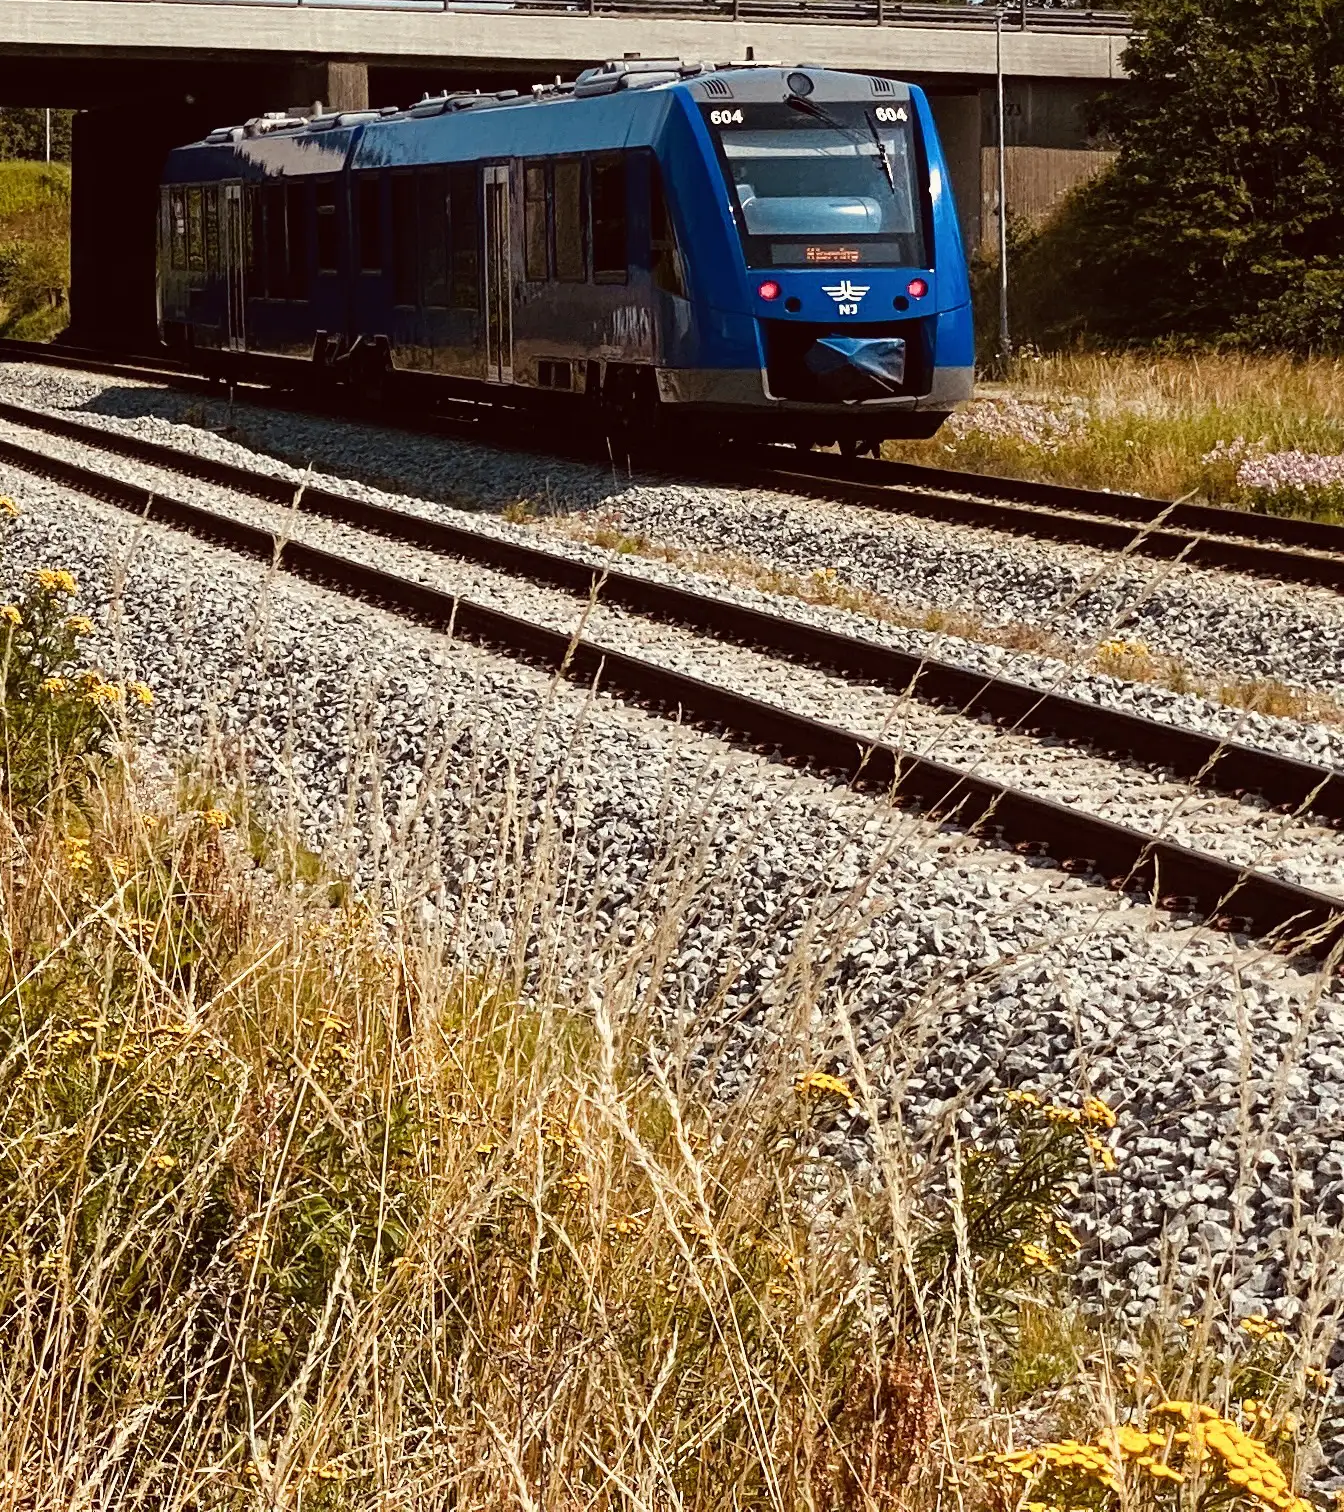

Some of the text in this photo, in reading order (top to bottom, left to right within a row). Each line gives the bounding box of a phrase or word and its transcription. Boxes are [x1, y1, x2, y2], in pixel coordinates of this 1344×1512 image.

[710, 109, 744, 125] 604
[875, 107, 908, 122] 604
[838, 304, 858, 315] NJ
